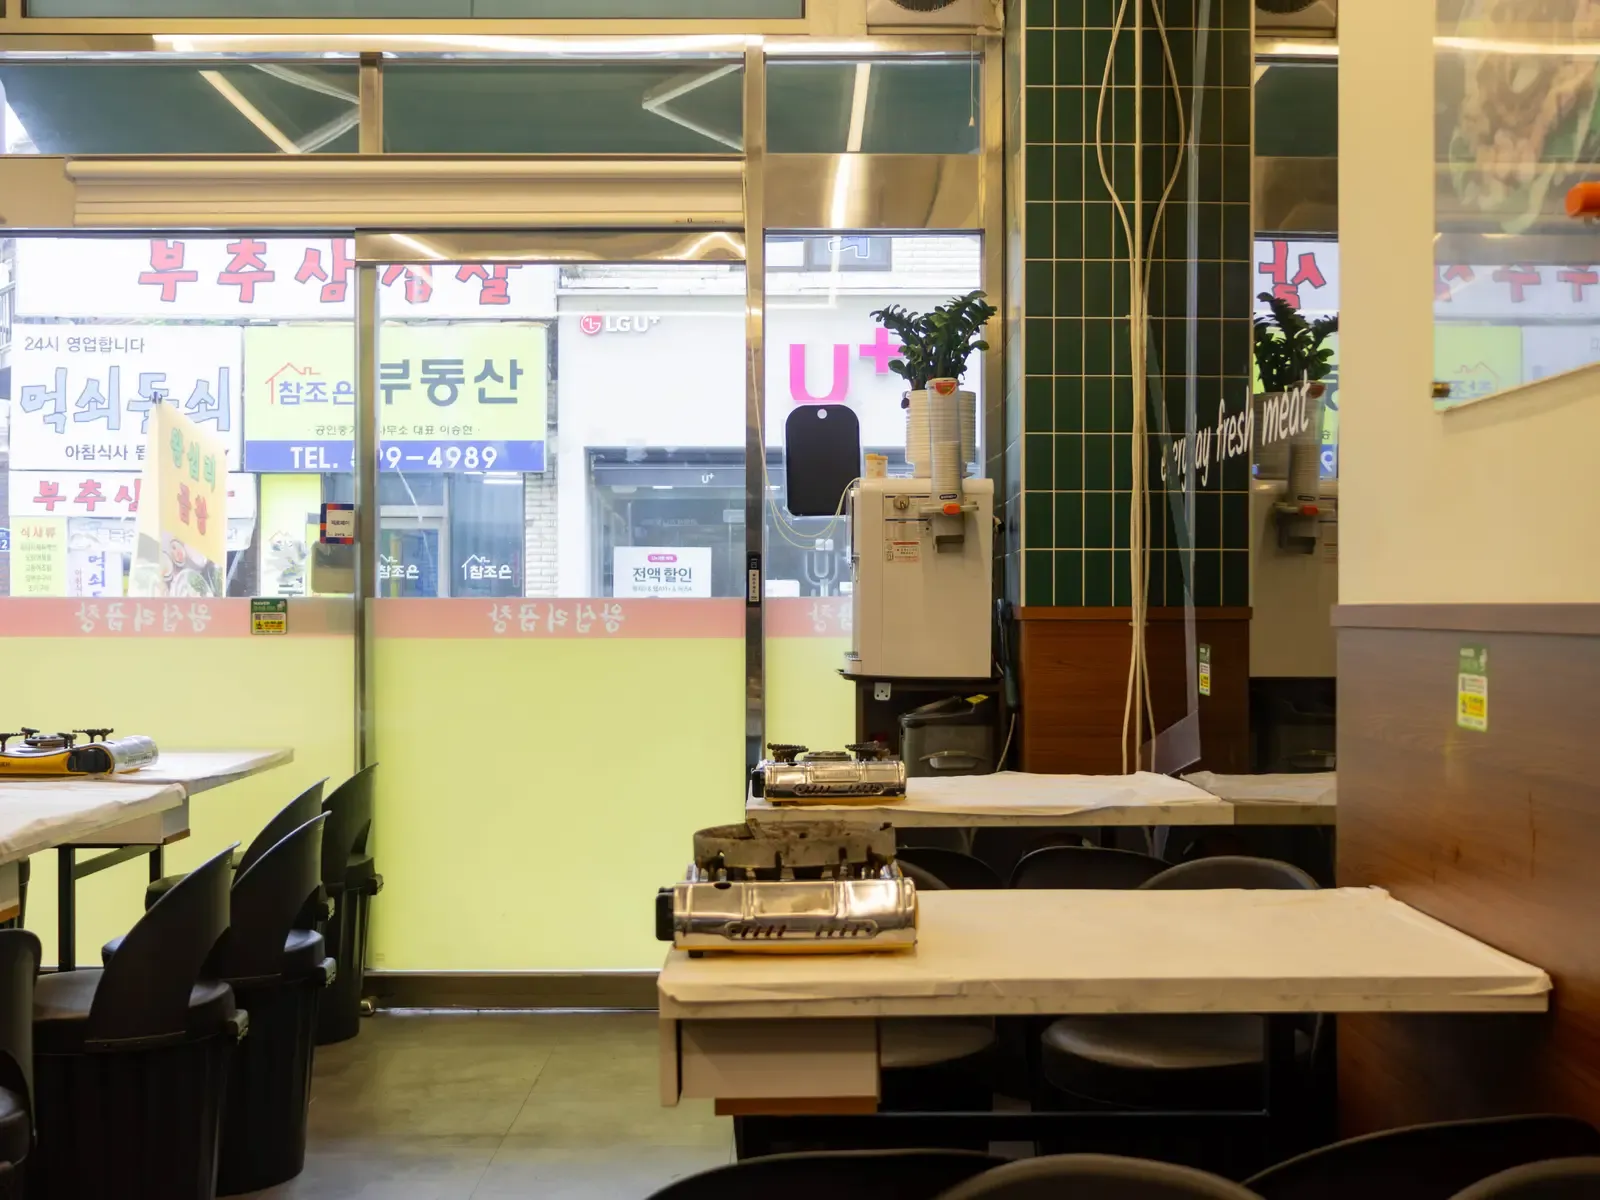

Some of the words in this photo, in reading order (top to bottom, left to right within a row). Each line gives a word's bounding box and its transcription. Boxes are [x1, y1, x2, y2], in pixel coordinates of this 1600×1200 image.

[24, 337, 59, 351] 24시
[66, 336, 145, 352] 영업합니다
[279, 381, 355, 405] 참조은
[380, 359, 523, 406] 부동산
[1216, 385, 1254, 462] fresh
[1262, 369, 1310, 446] meat
[315, 425, 408, 436] 공인중무소
[413, 425, 435, 436] 대표
[65, 444, 128, 460] 아침식사
[290, 446, 338, 469] TEL.
[350, 446, 498, 469] 9-4989
[701, 472, 715, 484] U+
[470, 564, 512, 579] 참조은
[632, 567, 660, 583] 전액
[664, 567, 692, 583] 할인
